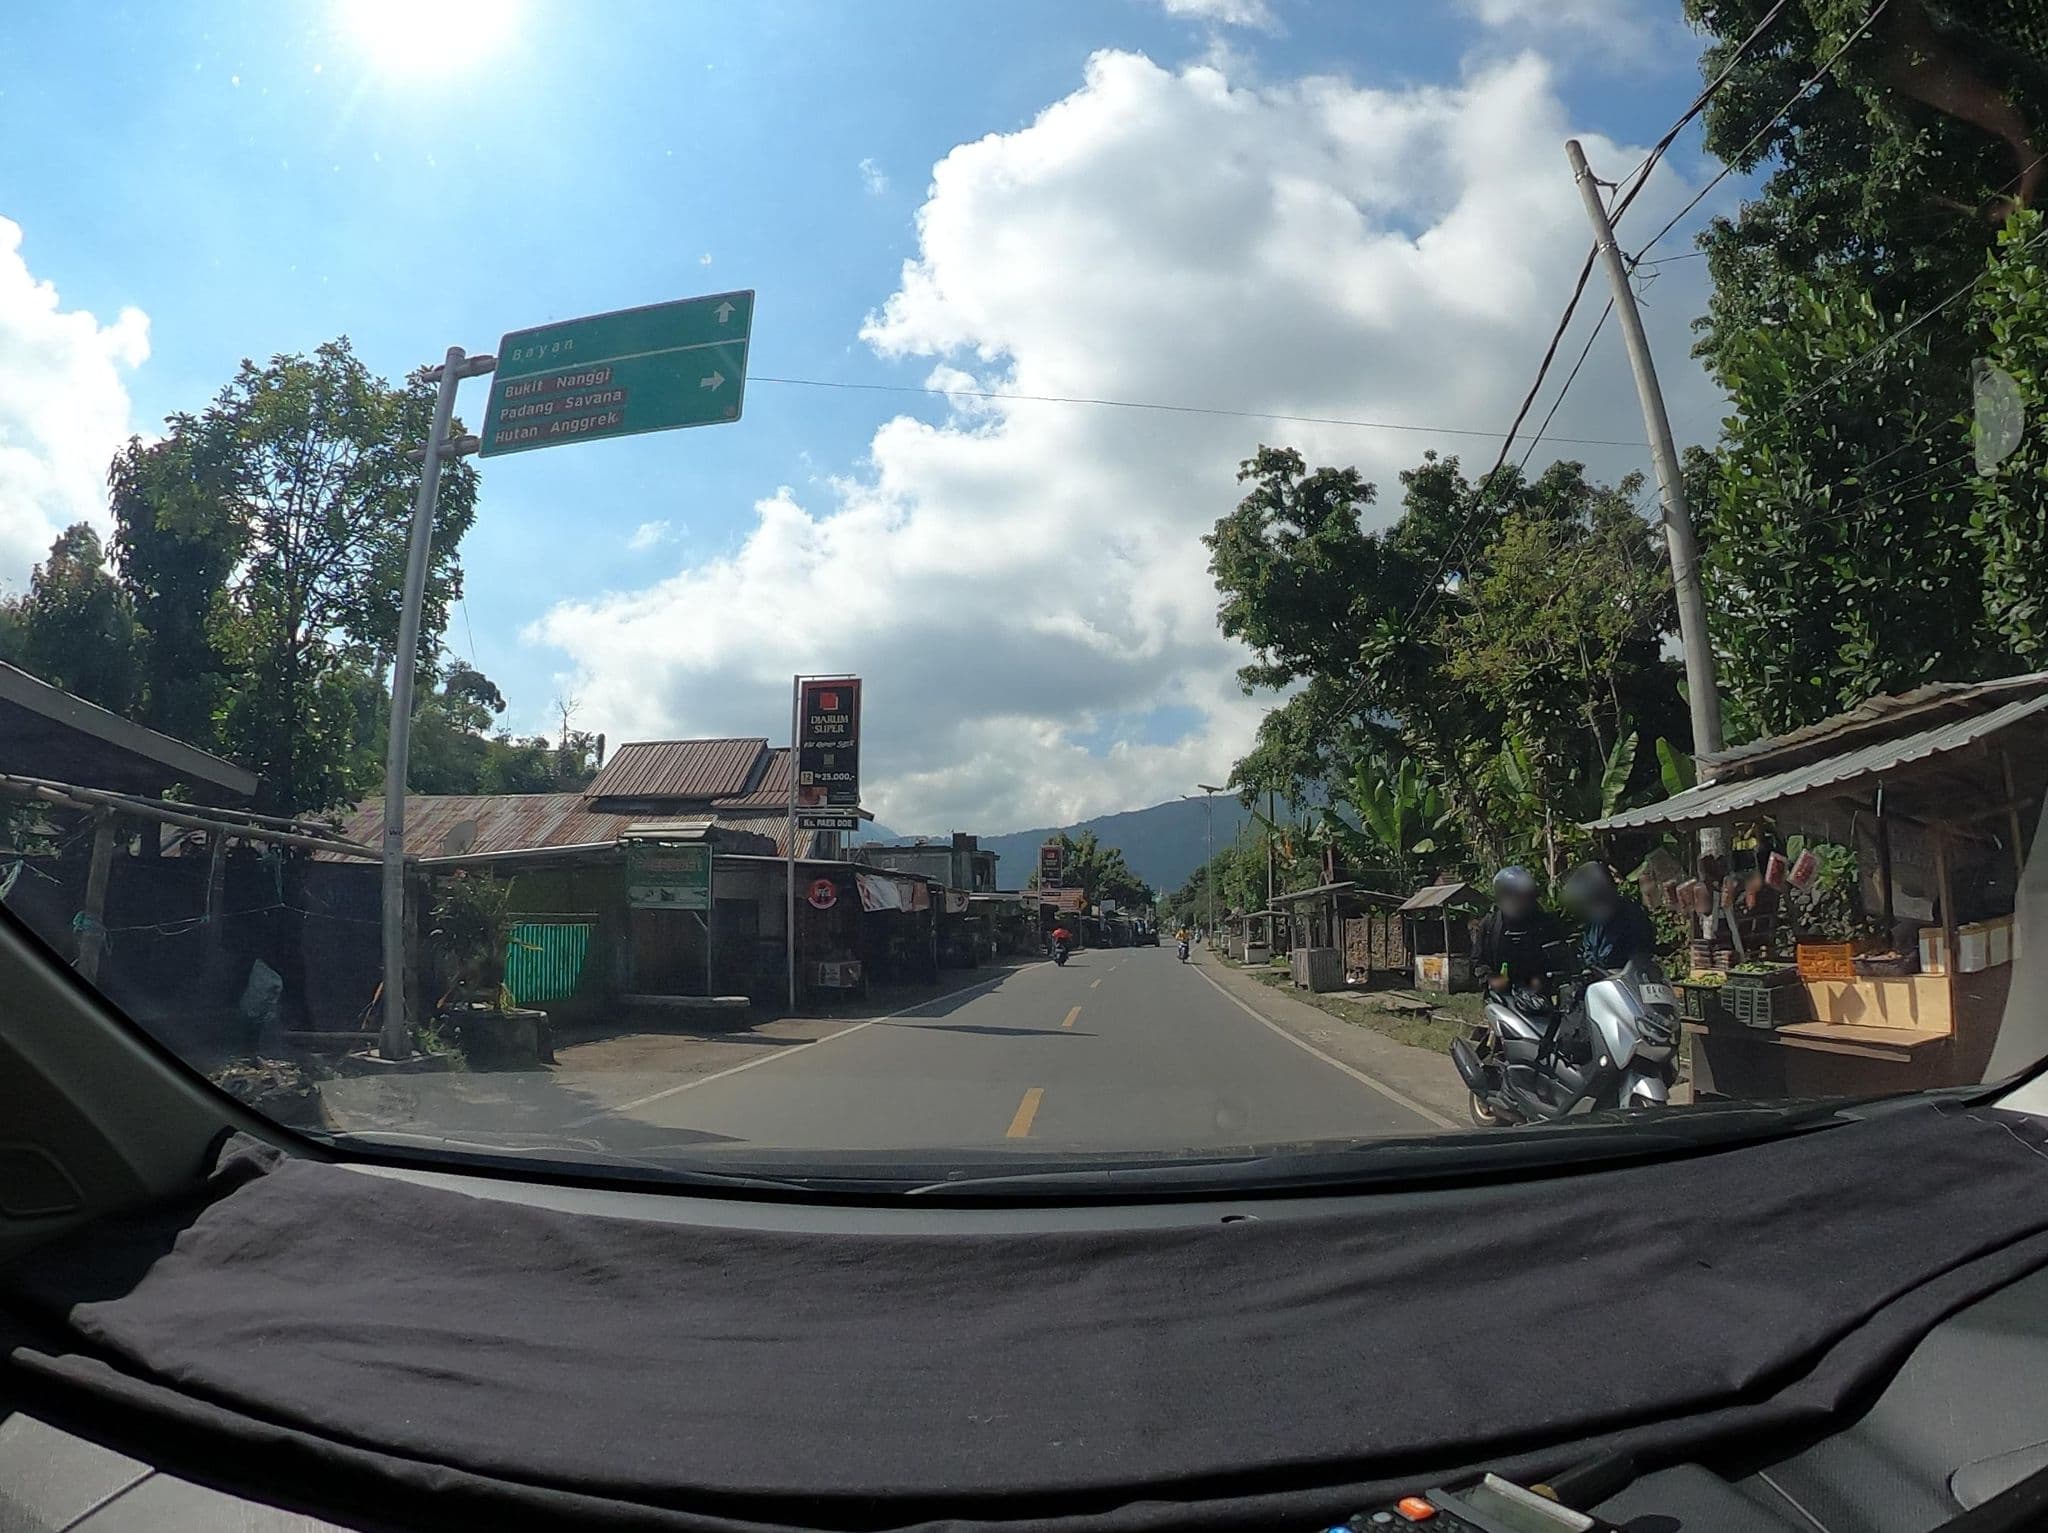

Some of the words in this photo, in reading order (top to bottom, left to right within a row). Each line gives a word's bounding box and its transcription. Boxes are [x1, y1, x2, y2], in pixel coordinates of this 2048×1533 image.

[512, 338, 574, 361] Bayan
[504, 379, 544, 398] Bukit
[556, 367, 611, 389] Nanggi
[500, 400, 554, 420] Padang
[565, 389, 623, 409] Savana
[495, 424, 538, 443] Hutan
[550, 411, 619, 434] Anggrek
[811, 714, 849, 725] DJARUM
[813, 724, 845, 734] SUPER
